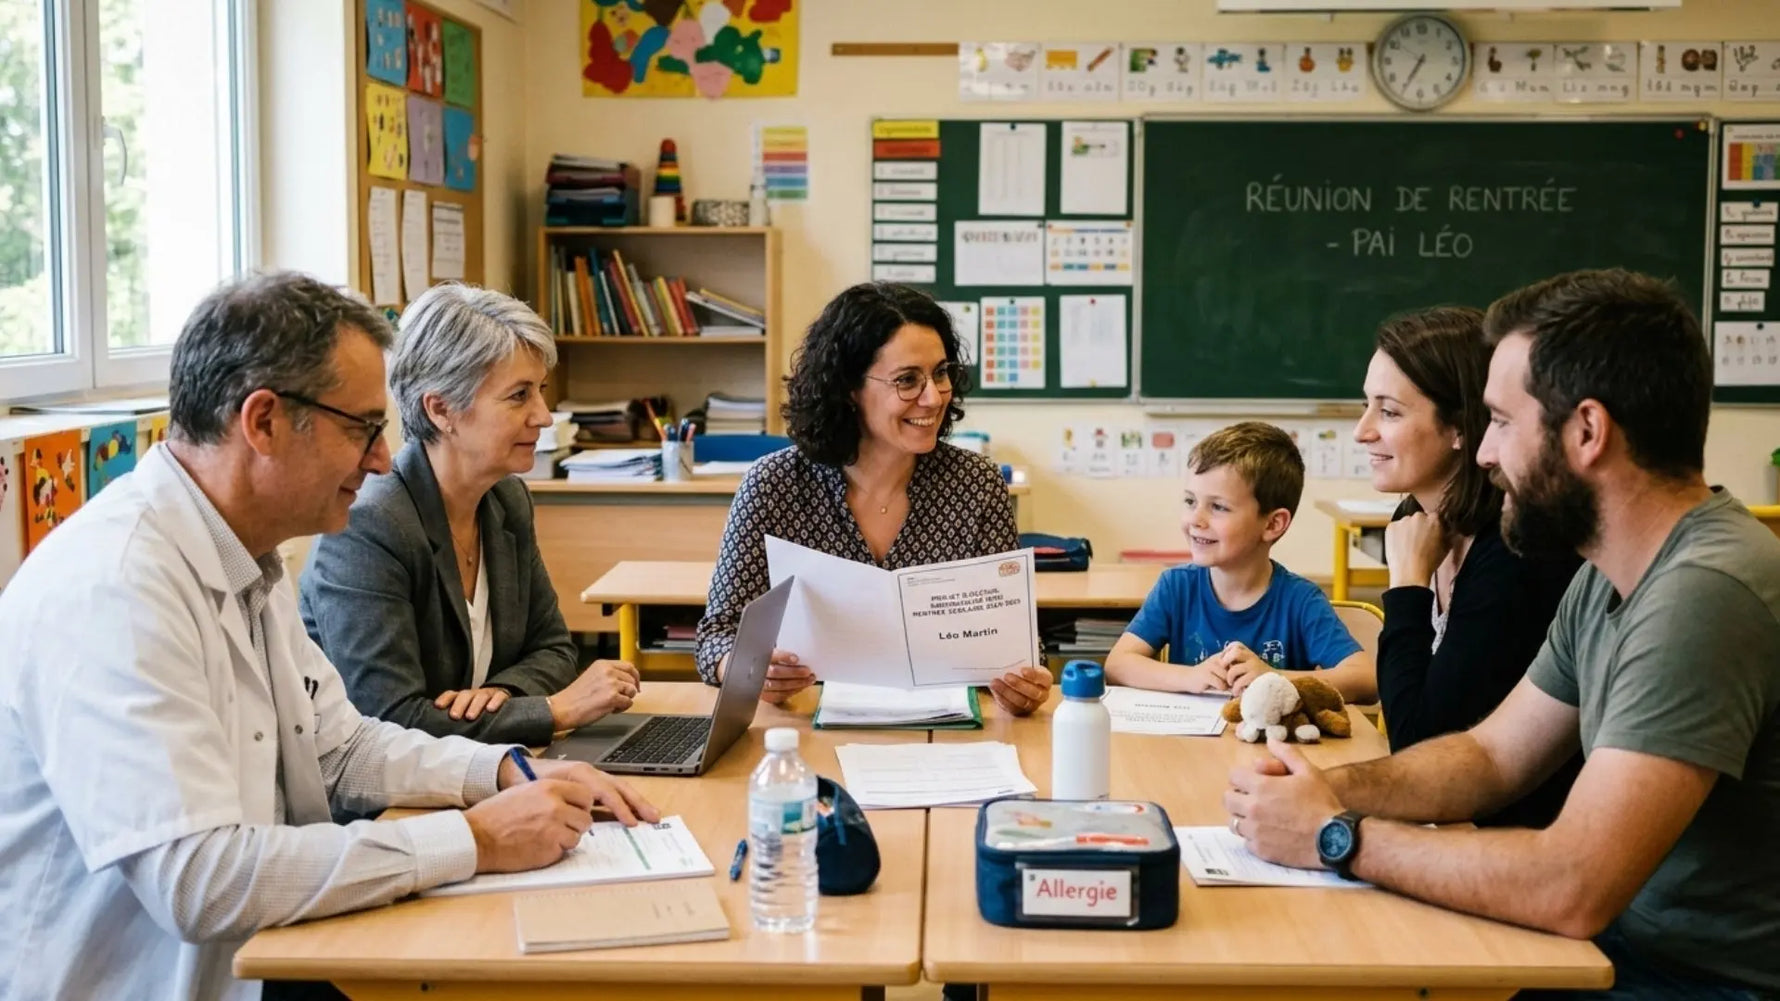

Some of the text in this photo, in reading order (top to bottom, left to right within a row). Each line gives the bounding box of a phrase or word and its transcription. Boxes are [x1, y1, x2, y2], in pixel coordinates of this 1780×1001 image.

[1395, 186, 1431, 212] DE
[1449, 177, 1577, 212] RENTRÉE
[1418, 223, 1473, 258] LÉO
[938, 627, 998, 640] Léo Martin
[1036, 878, 1117, 907] Allergie
